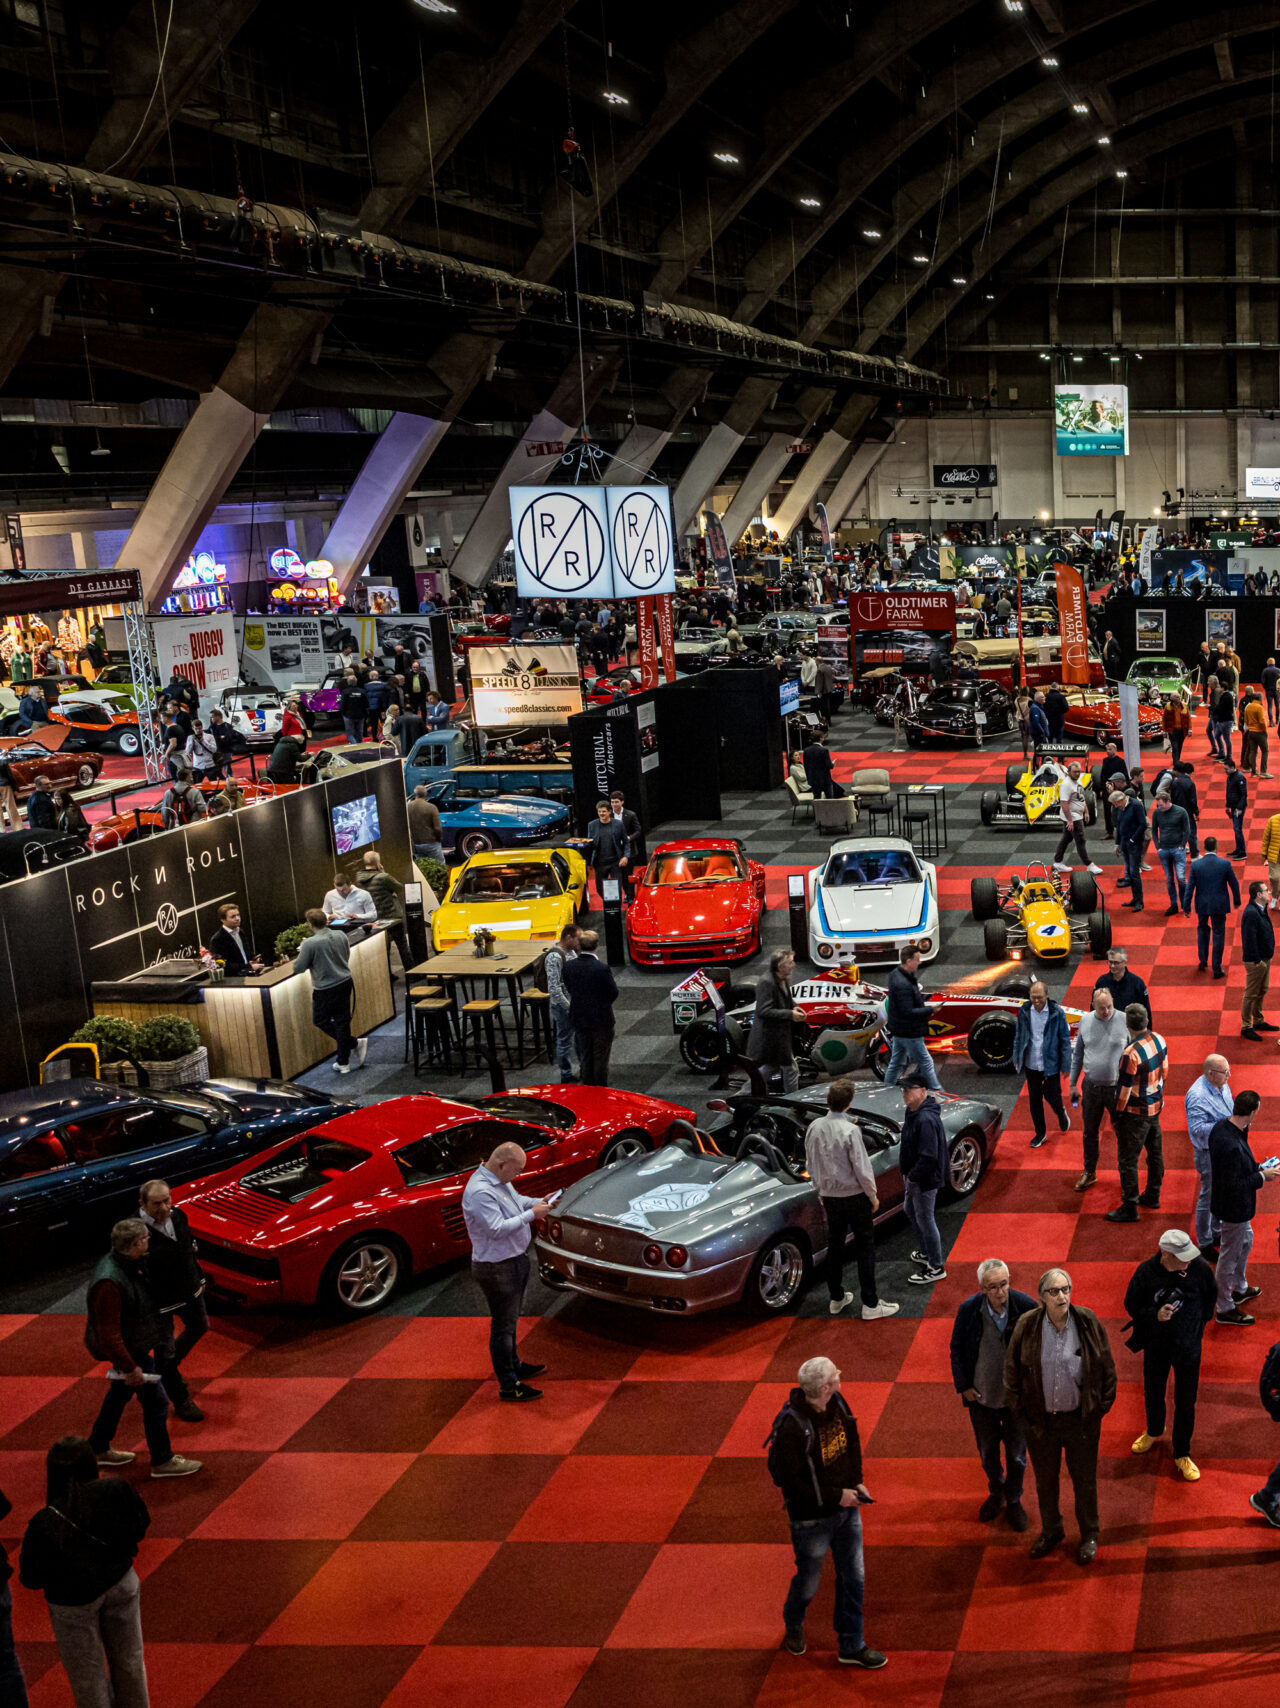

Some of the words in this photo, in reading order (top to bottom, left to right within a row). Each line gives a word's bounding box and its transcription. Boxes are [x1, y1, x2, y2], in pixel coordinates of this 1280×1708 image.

[540, 513, 557, 538] R
[628, 513, 639, 538] R
[564, 551, 581, 576] R
[645, 549, 655, 573] R
[885, 597, 948, 608] OLDTIMER
[886, 609, 924, 620] FARM.
[172, 644, 189, 657] ITS
[189, 629, 224, 660] BUGGY
[483, 676, 515, 688] SPEED
[521, 674, 531, 689] 8
[593, 732, 609, 796] ARTCURIAL
[76, 874, 141, 912] ROCK
[186, 842, 237, 873] ROLL
[1041, 925, 1057, 936] 4
[150, 945, 197, 967] clasics.
[791, 985, 852, 998] VELTINS
